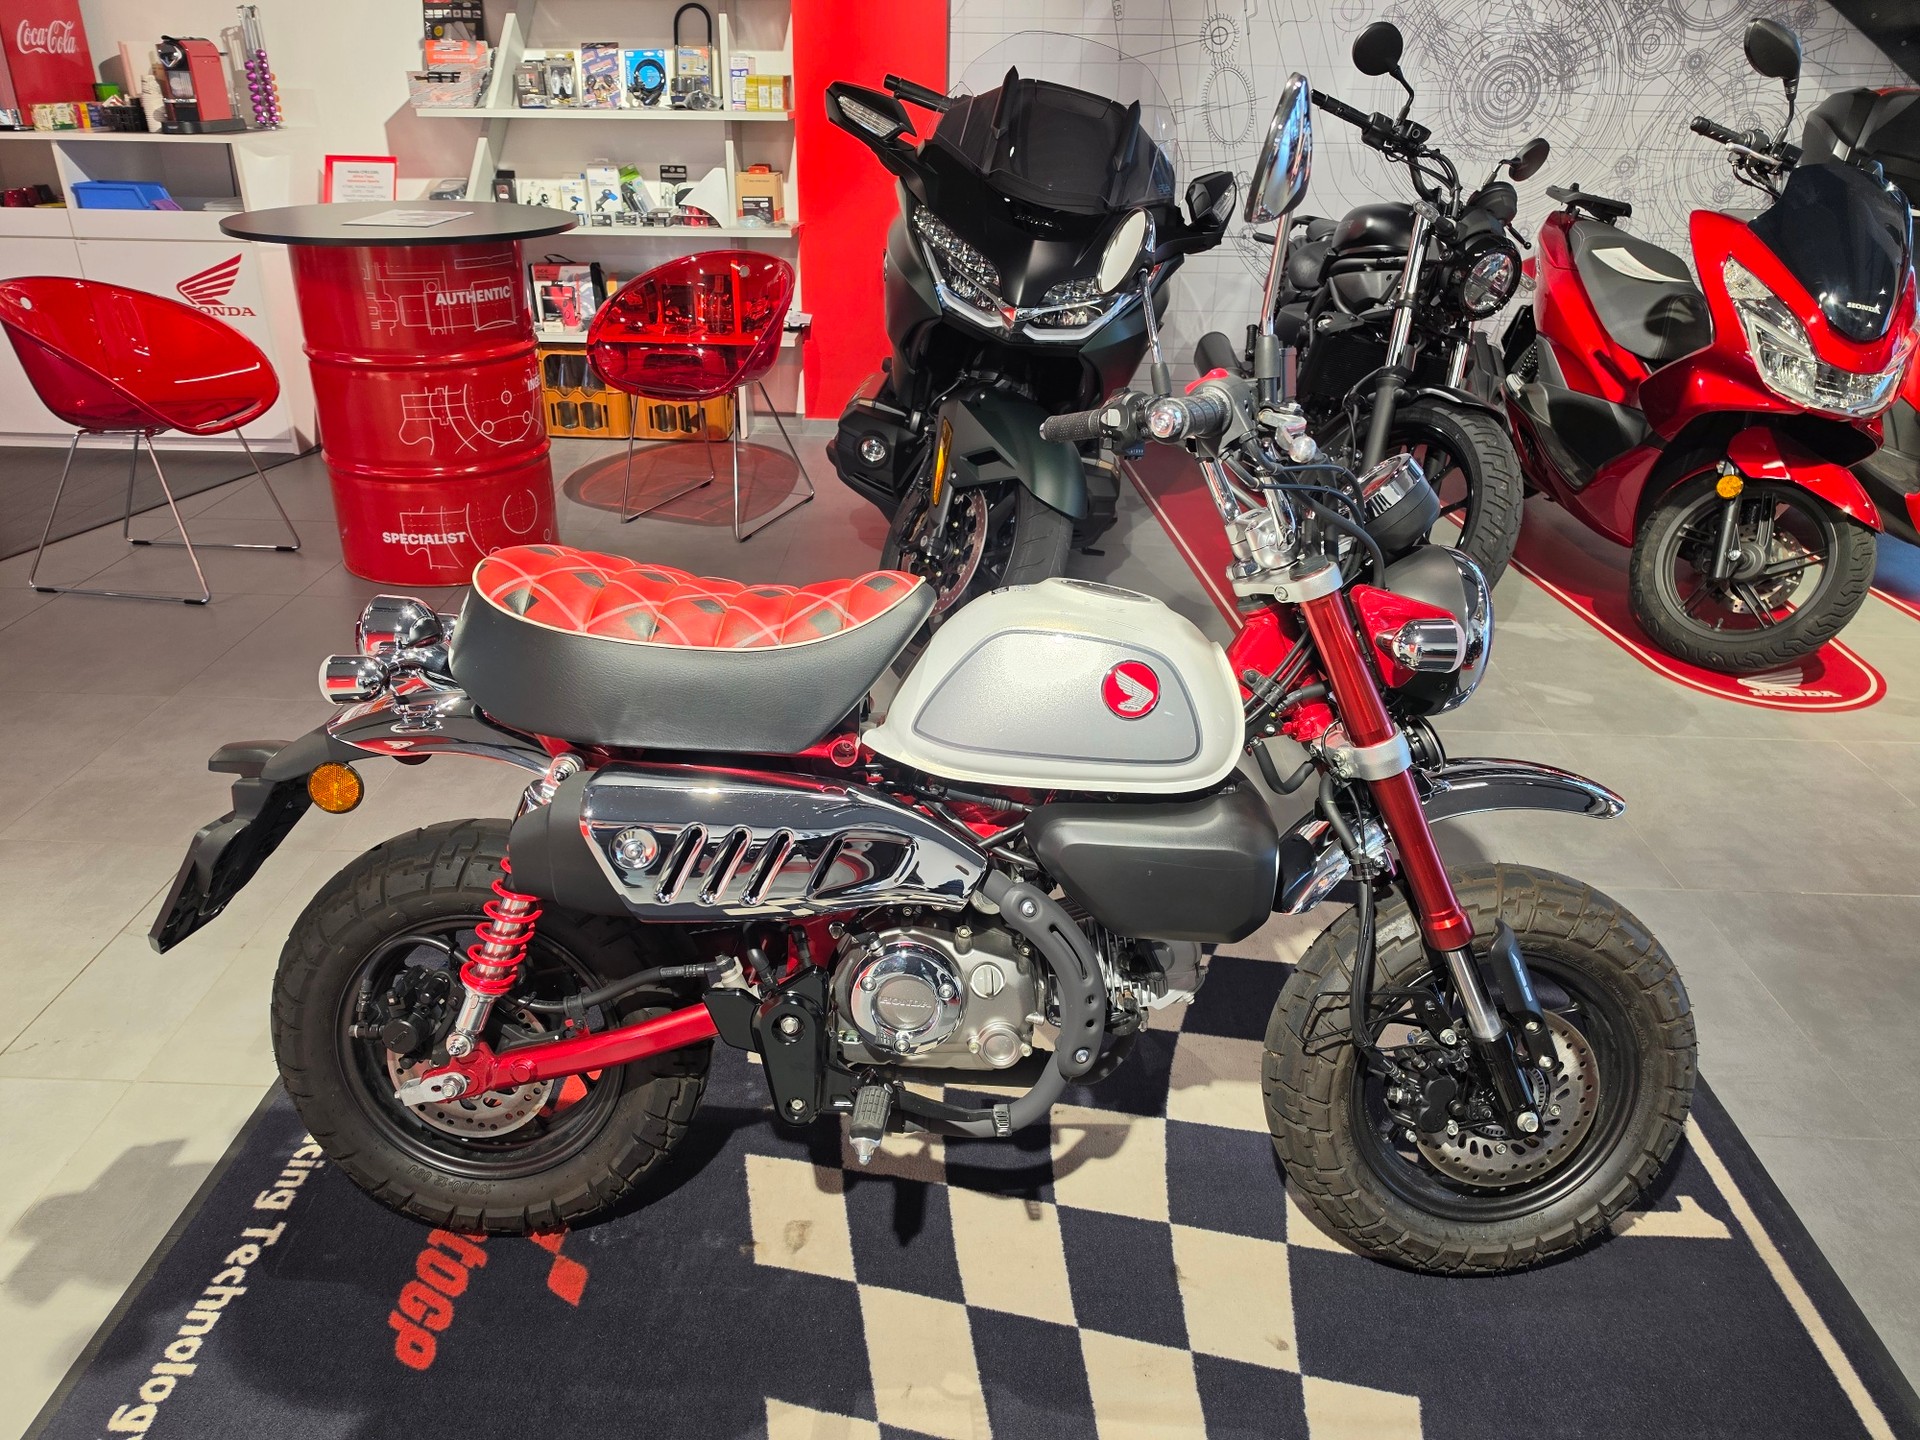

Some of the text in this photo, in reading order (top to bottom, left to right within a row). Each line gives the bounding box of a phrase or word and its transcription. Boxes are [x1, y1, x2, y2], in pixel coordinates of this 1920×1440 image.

[435, 285, 511, 306] AUTHENTIC
[195, 306, 257, 317] ONDA
[1846, 301, 1881, 315] HONDA
[382, 531, 466, 545] SPECIALIST
[1748, 688, 1842, 698] HONDA
[253, 1133, 326, 1211] cing
